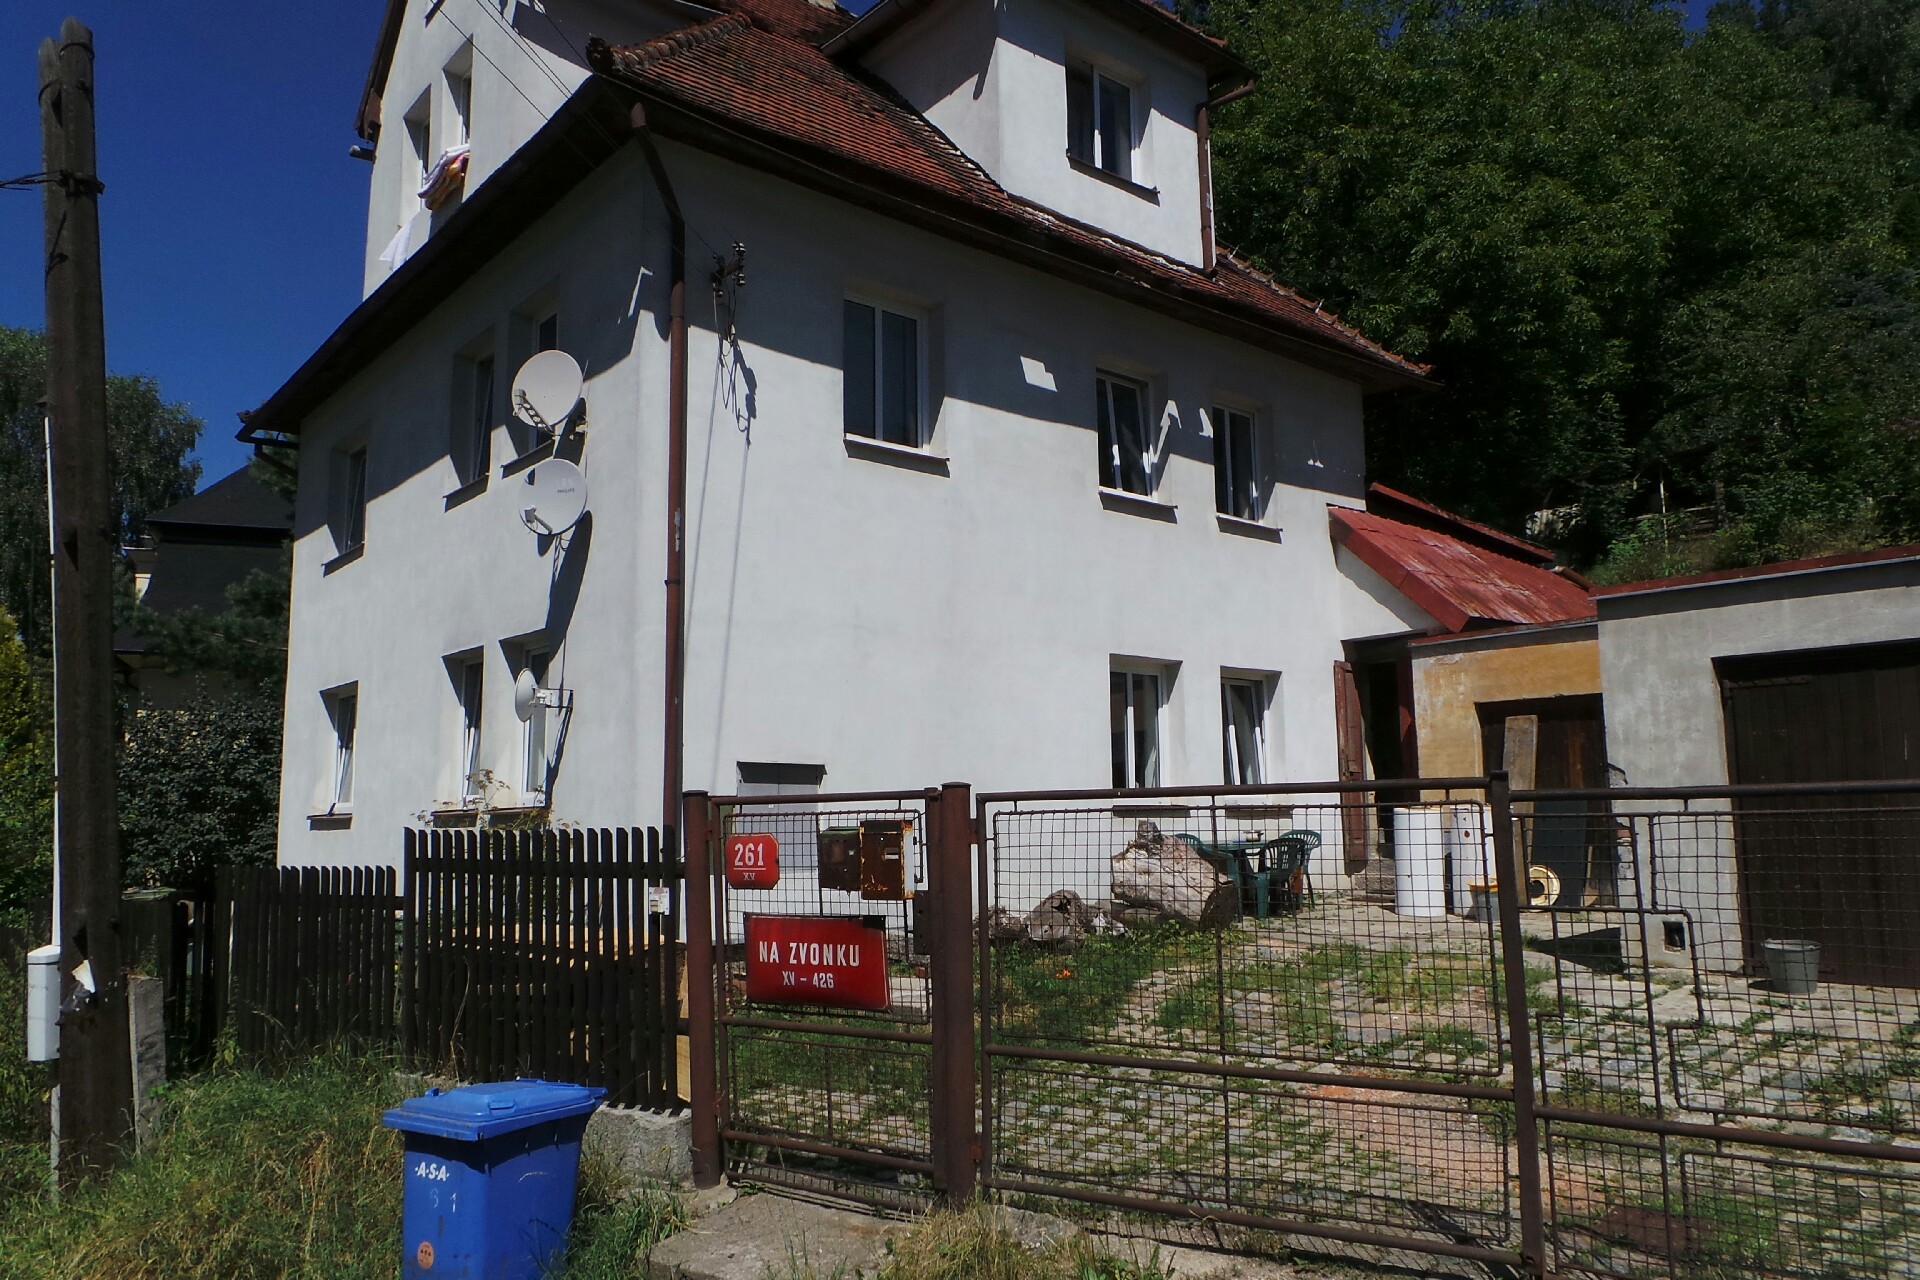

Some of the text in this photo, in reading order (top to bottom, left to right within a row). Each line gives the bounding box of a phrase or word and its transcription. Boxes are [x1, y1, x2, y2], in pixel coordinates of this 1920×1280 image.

[734, 843, 764, 866] 261
[743, 872, 756, 881] XV
[759, 941, 860, 967] NA ZVONKU
[782, 970, 795, 986] XV
[812, 972, 834, 989] 426
